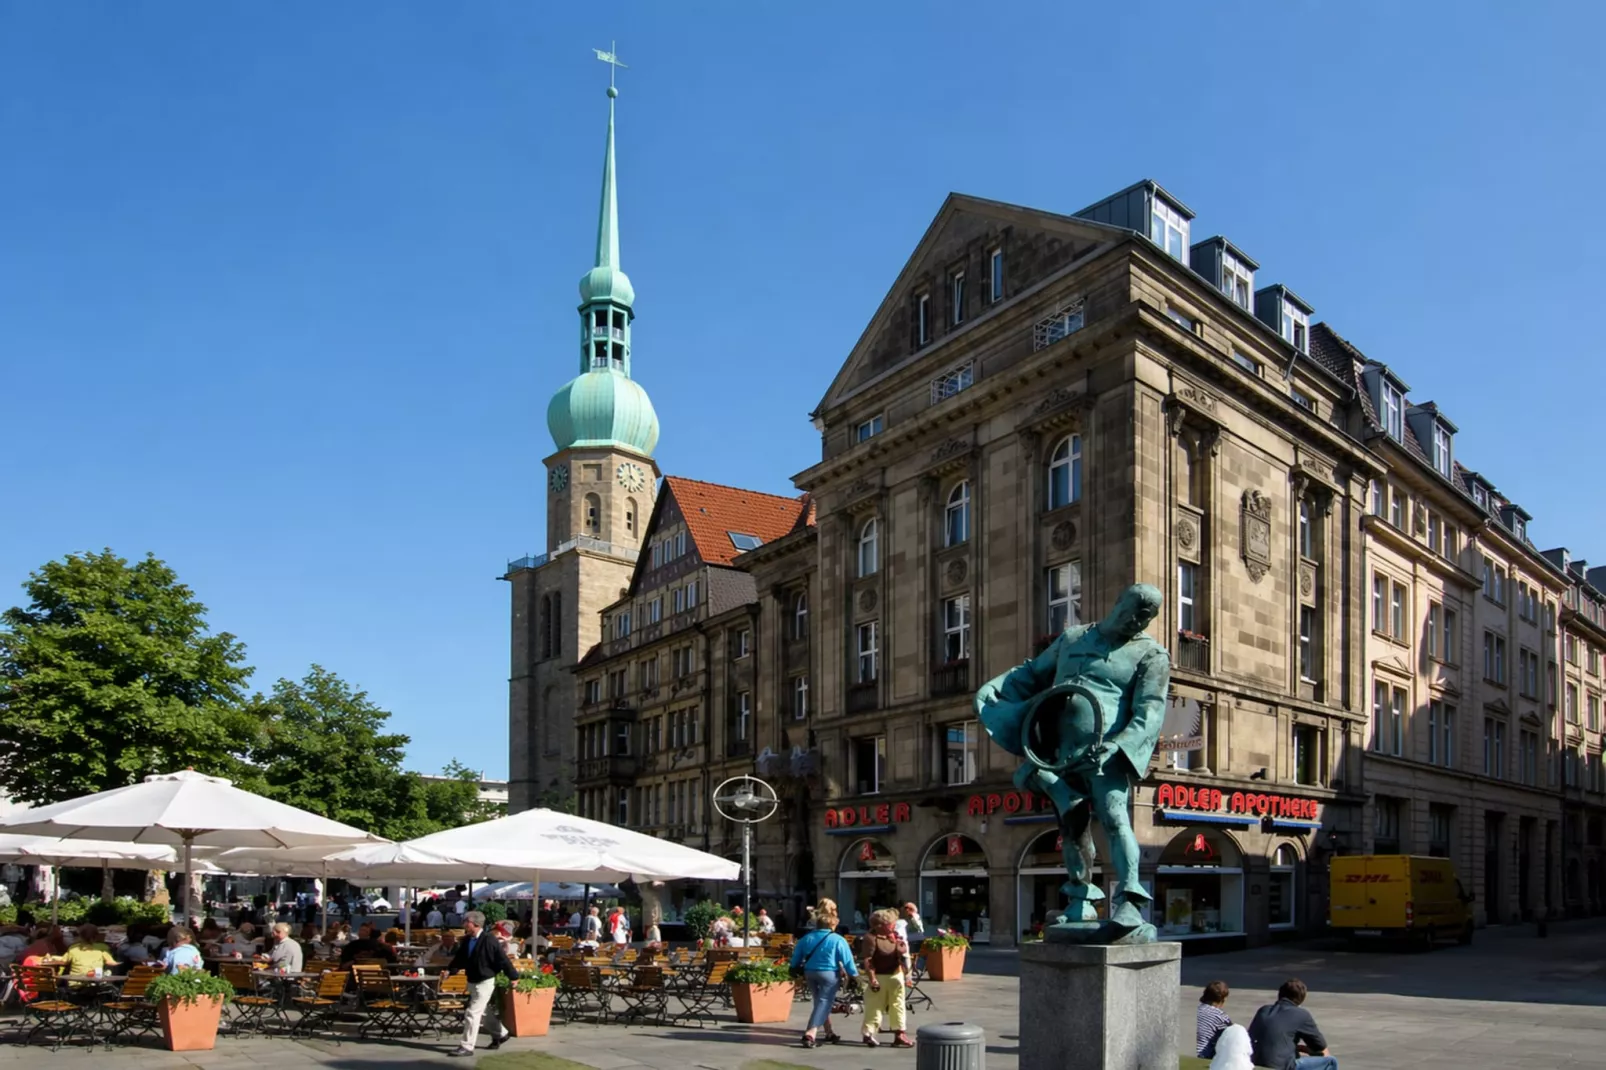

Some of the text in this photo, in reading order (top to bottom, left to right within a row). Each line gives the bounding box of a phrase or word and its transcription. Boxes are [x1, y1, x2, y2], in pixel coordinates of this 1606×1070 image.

[1158, 784, 1318, 818] ADLER APOTHEKE
[825, 802, 911, 828] ADLER
[1346, 874, 1391, 883] DHL
